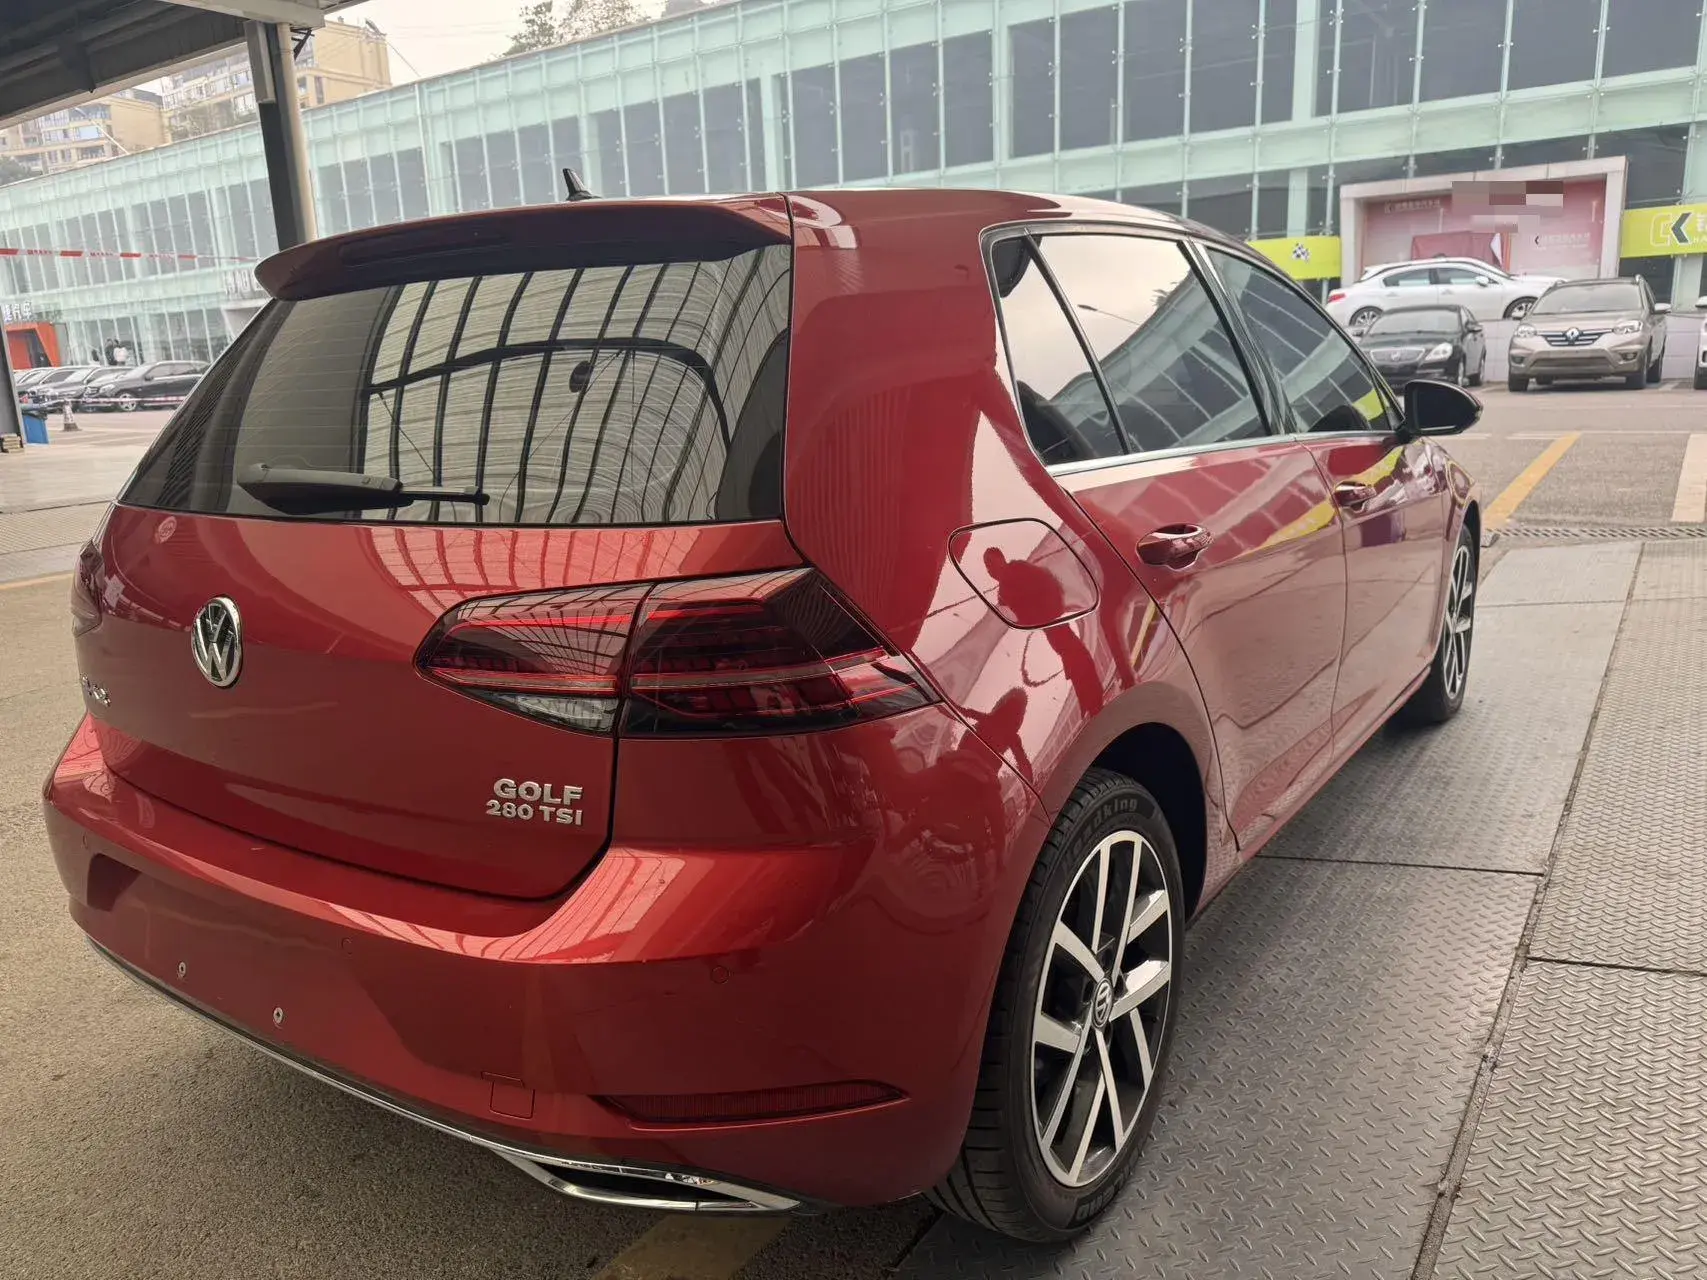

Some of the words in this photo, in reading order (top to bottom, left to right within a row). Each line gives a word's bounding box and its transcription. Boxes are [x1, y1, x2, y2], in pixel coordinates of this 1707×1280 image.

[493, 778, 583, 805] GOLF
[485, 799, 534, 821] 280
[539, 805, 583, 826] TSI
